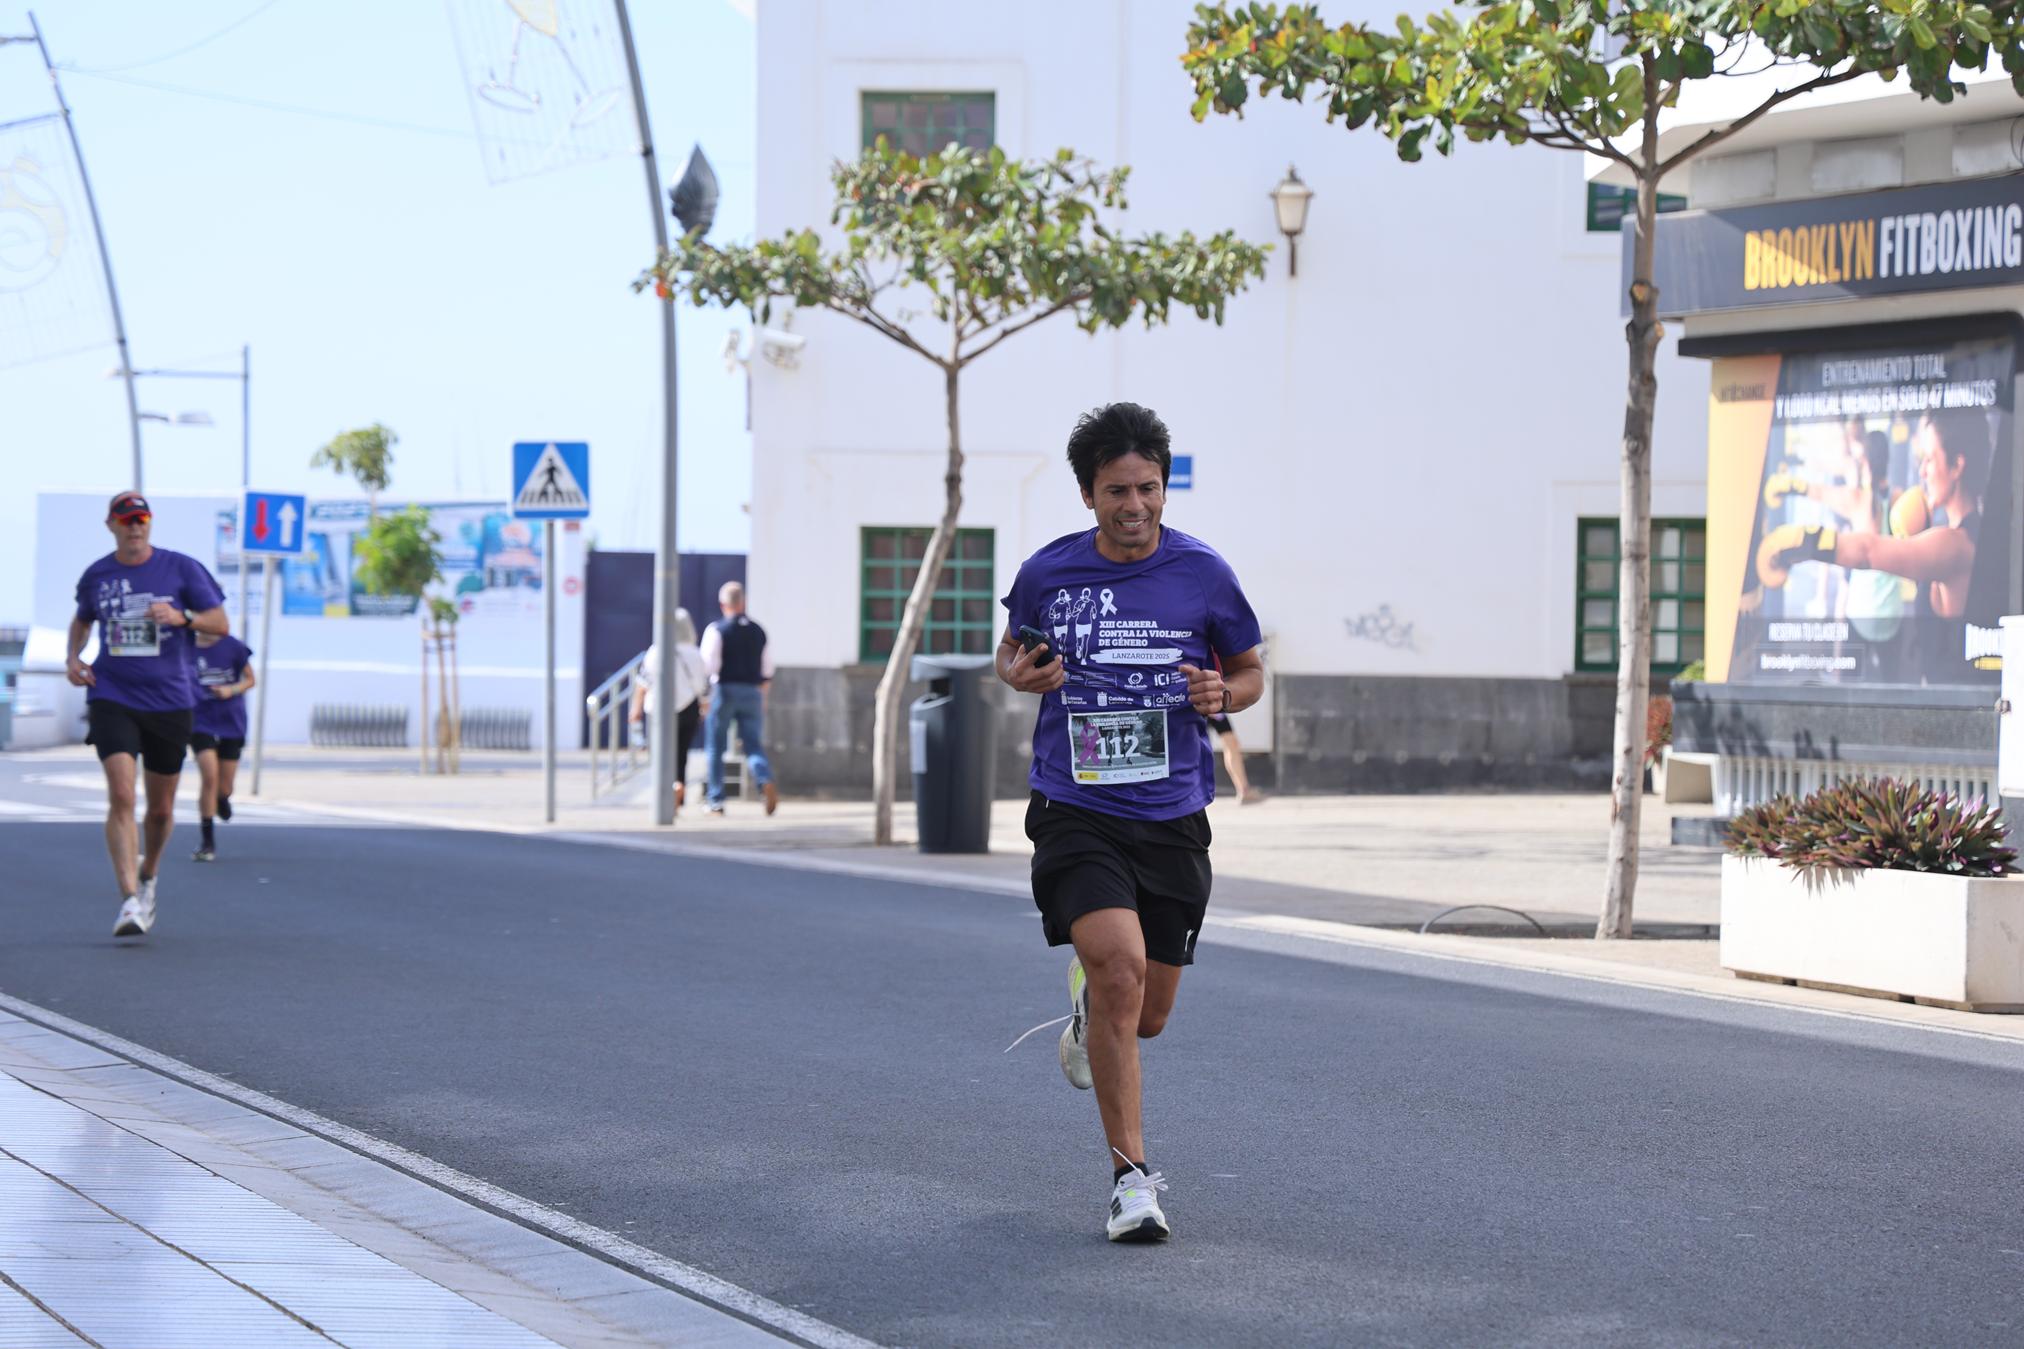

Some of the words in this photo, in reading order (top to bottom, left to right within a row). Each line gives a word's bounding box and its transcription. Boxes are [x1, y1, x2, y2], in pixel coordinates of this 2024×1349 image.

[1743, 218, 1875, 291] BROOKLYN
[1879, 203, 2023, 279] FITBOXING
[1913, 353, 1947, 380] TOTAL
[1943, 378, 1997, 408] MINUTOS
[1099, 620, 1116, 629] XIII
[1116, 620, 1158, 629] CARRERA
[1099, 629, 1135, 638] CONTRA
[1136, 630, 1148, 638] LA
[1098, 638, 1111, 647] DE
[1111, 636, 1148, 647] GÉNERO
[1112, 652, 1154, 660] LANZAROTE
[1095, 735, 1141, 760] 112
